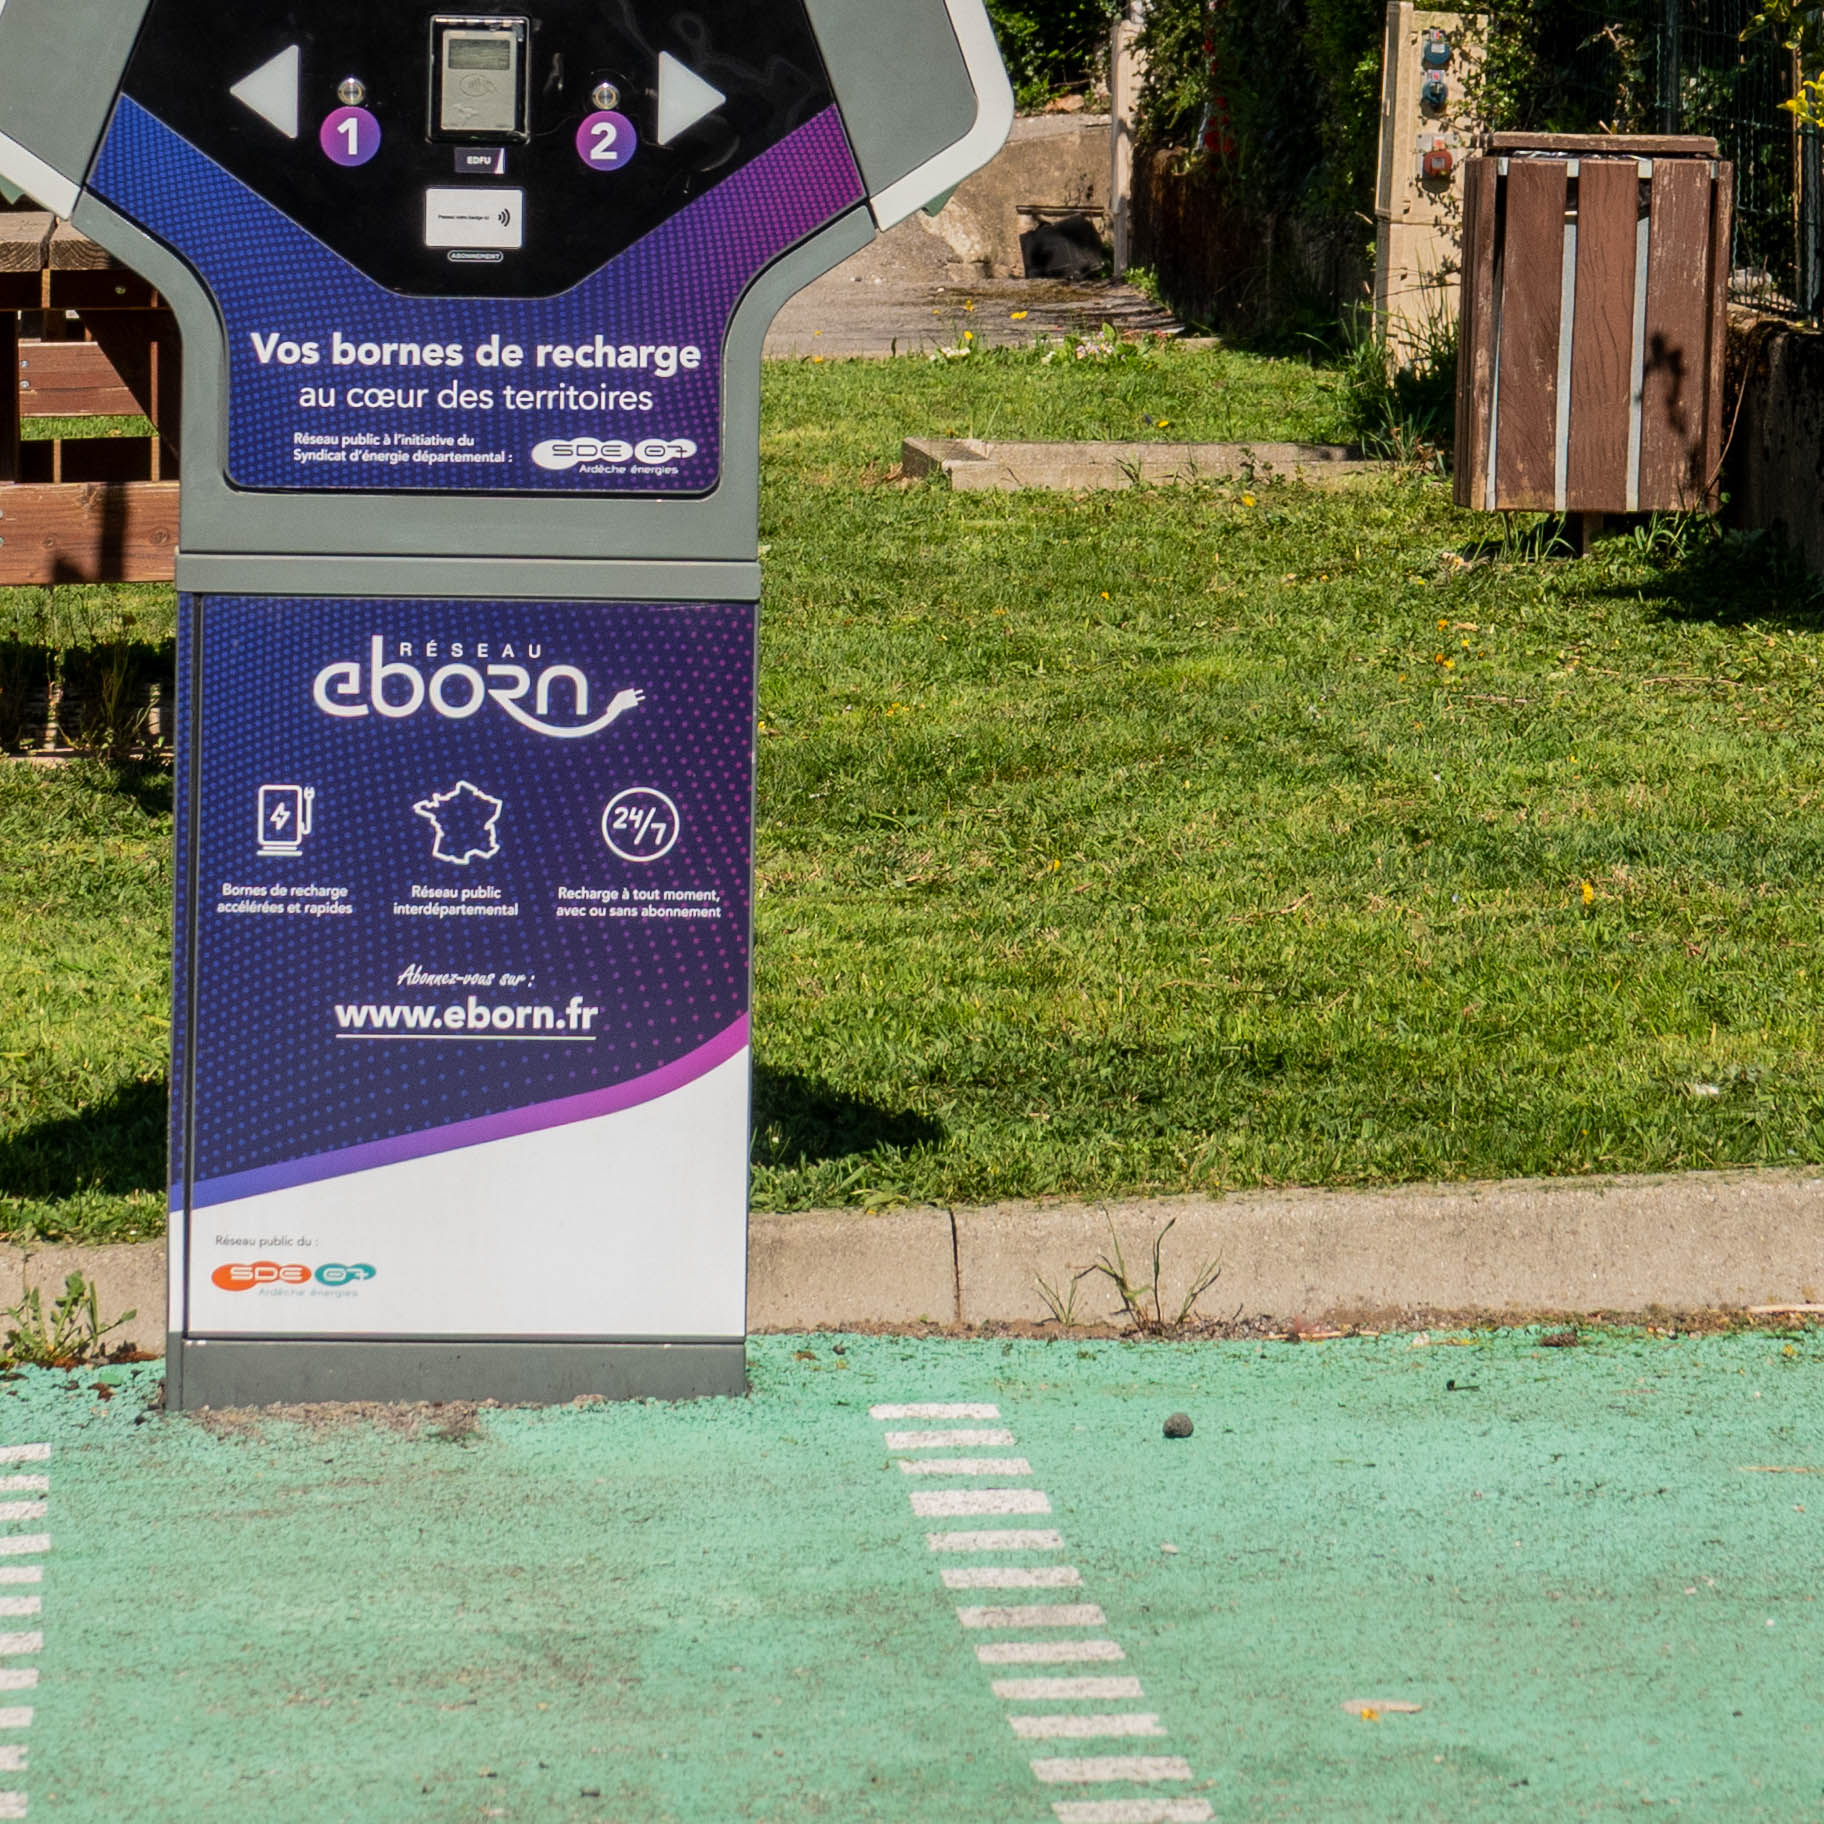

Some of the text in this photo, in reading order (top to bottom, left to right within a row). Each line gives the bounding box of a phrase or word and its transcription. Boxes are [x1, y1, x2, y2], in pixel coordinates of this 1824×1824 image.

[337, 118, 359, 156] 1
[589, 122, 618, 160] 2
[466, 155, 492, 165] EDFU
[250, 332, 702, 377] Vos bornes de recharge
[299, 379, 654, 411] au cœur des territoires
[293, 432, 339, 445] Réseau
[341, 433, 381, 448] public
[382, 433, 391, 445] à
[456, 434, 475, 446] du
[293, 449, 347, 464] Syndicat
[349, 449, 410, 465] d'énergie
[413, 450, 506, 466] départemental
[552, 444, 622, 457] SDE
[579, 464, 679, 476] Ardèche énergies
[399, 640, 542, 659] RÉSEAU
[313, 635, 646, 738] eborn
[612, 806, 667, 845] 24/7
[222, 883, 349, 900] Bornes de recharge
[411, 884, 502, 901] Réseau public
[558, 886, 721, 903] Recharge à tout moment,
[217, 900, 353, 917] accélérées et rapides
[393, 901, 519, 919] interdépartemental
[556, 904, 722, 918] avec ou sans abonnement
[397, 963, 496, 987] Abonnez-vous
[499, 972, 526, 987] sur
[334, 995, 599, 1030] www.eborn.fr
[215, 1234, 256, 1246] Réseau
[259, 1235, 294, 1248] public
[297, 1236, 312, 1247] du
[230, 1266, 303, 1281] SDE
